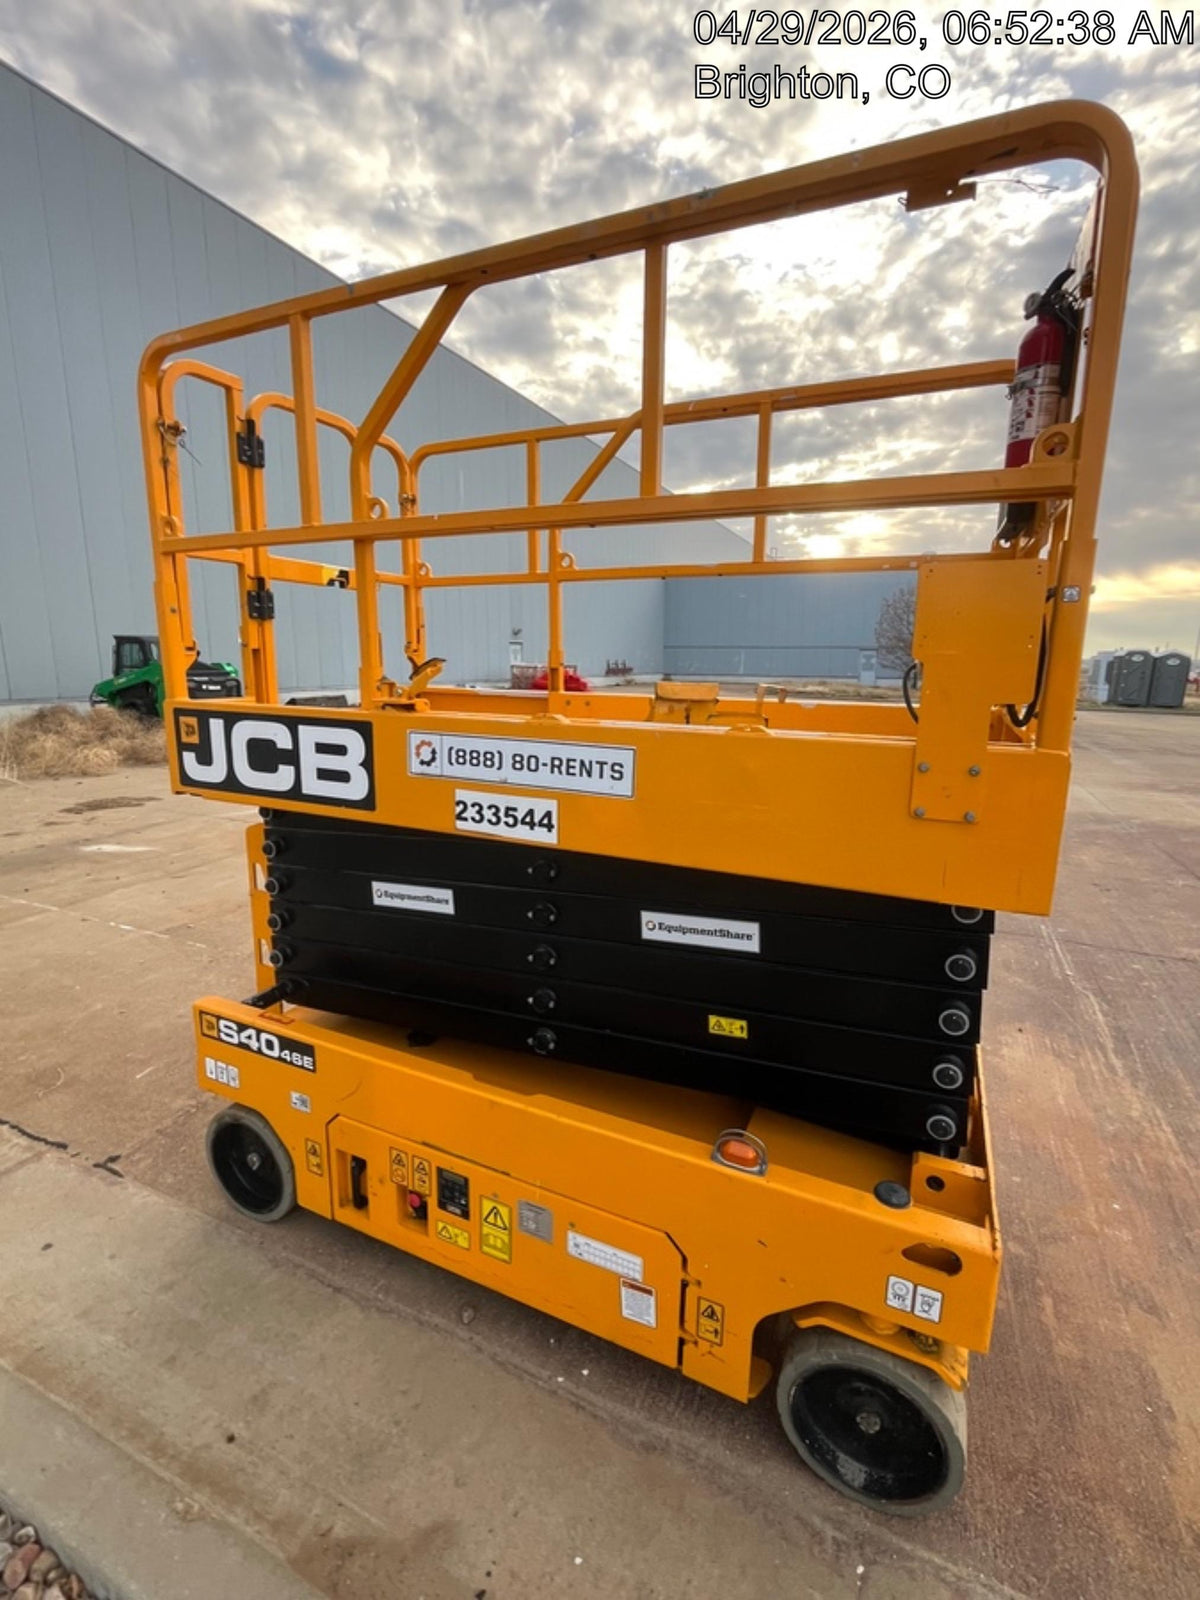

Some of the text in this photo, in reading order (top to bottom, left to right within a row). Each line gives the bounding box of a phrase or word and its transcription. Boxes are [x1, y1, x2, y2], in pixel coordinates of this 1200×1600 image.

[182, 718, 369, 801] JCB
[447, 746, 624, 782] (888) 80-RENTS
[456, 800, 555, 832] 233544
[658, 922, 753, 941] EquipmentShare
